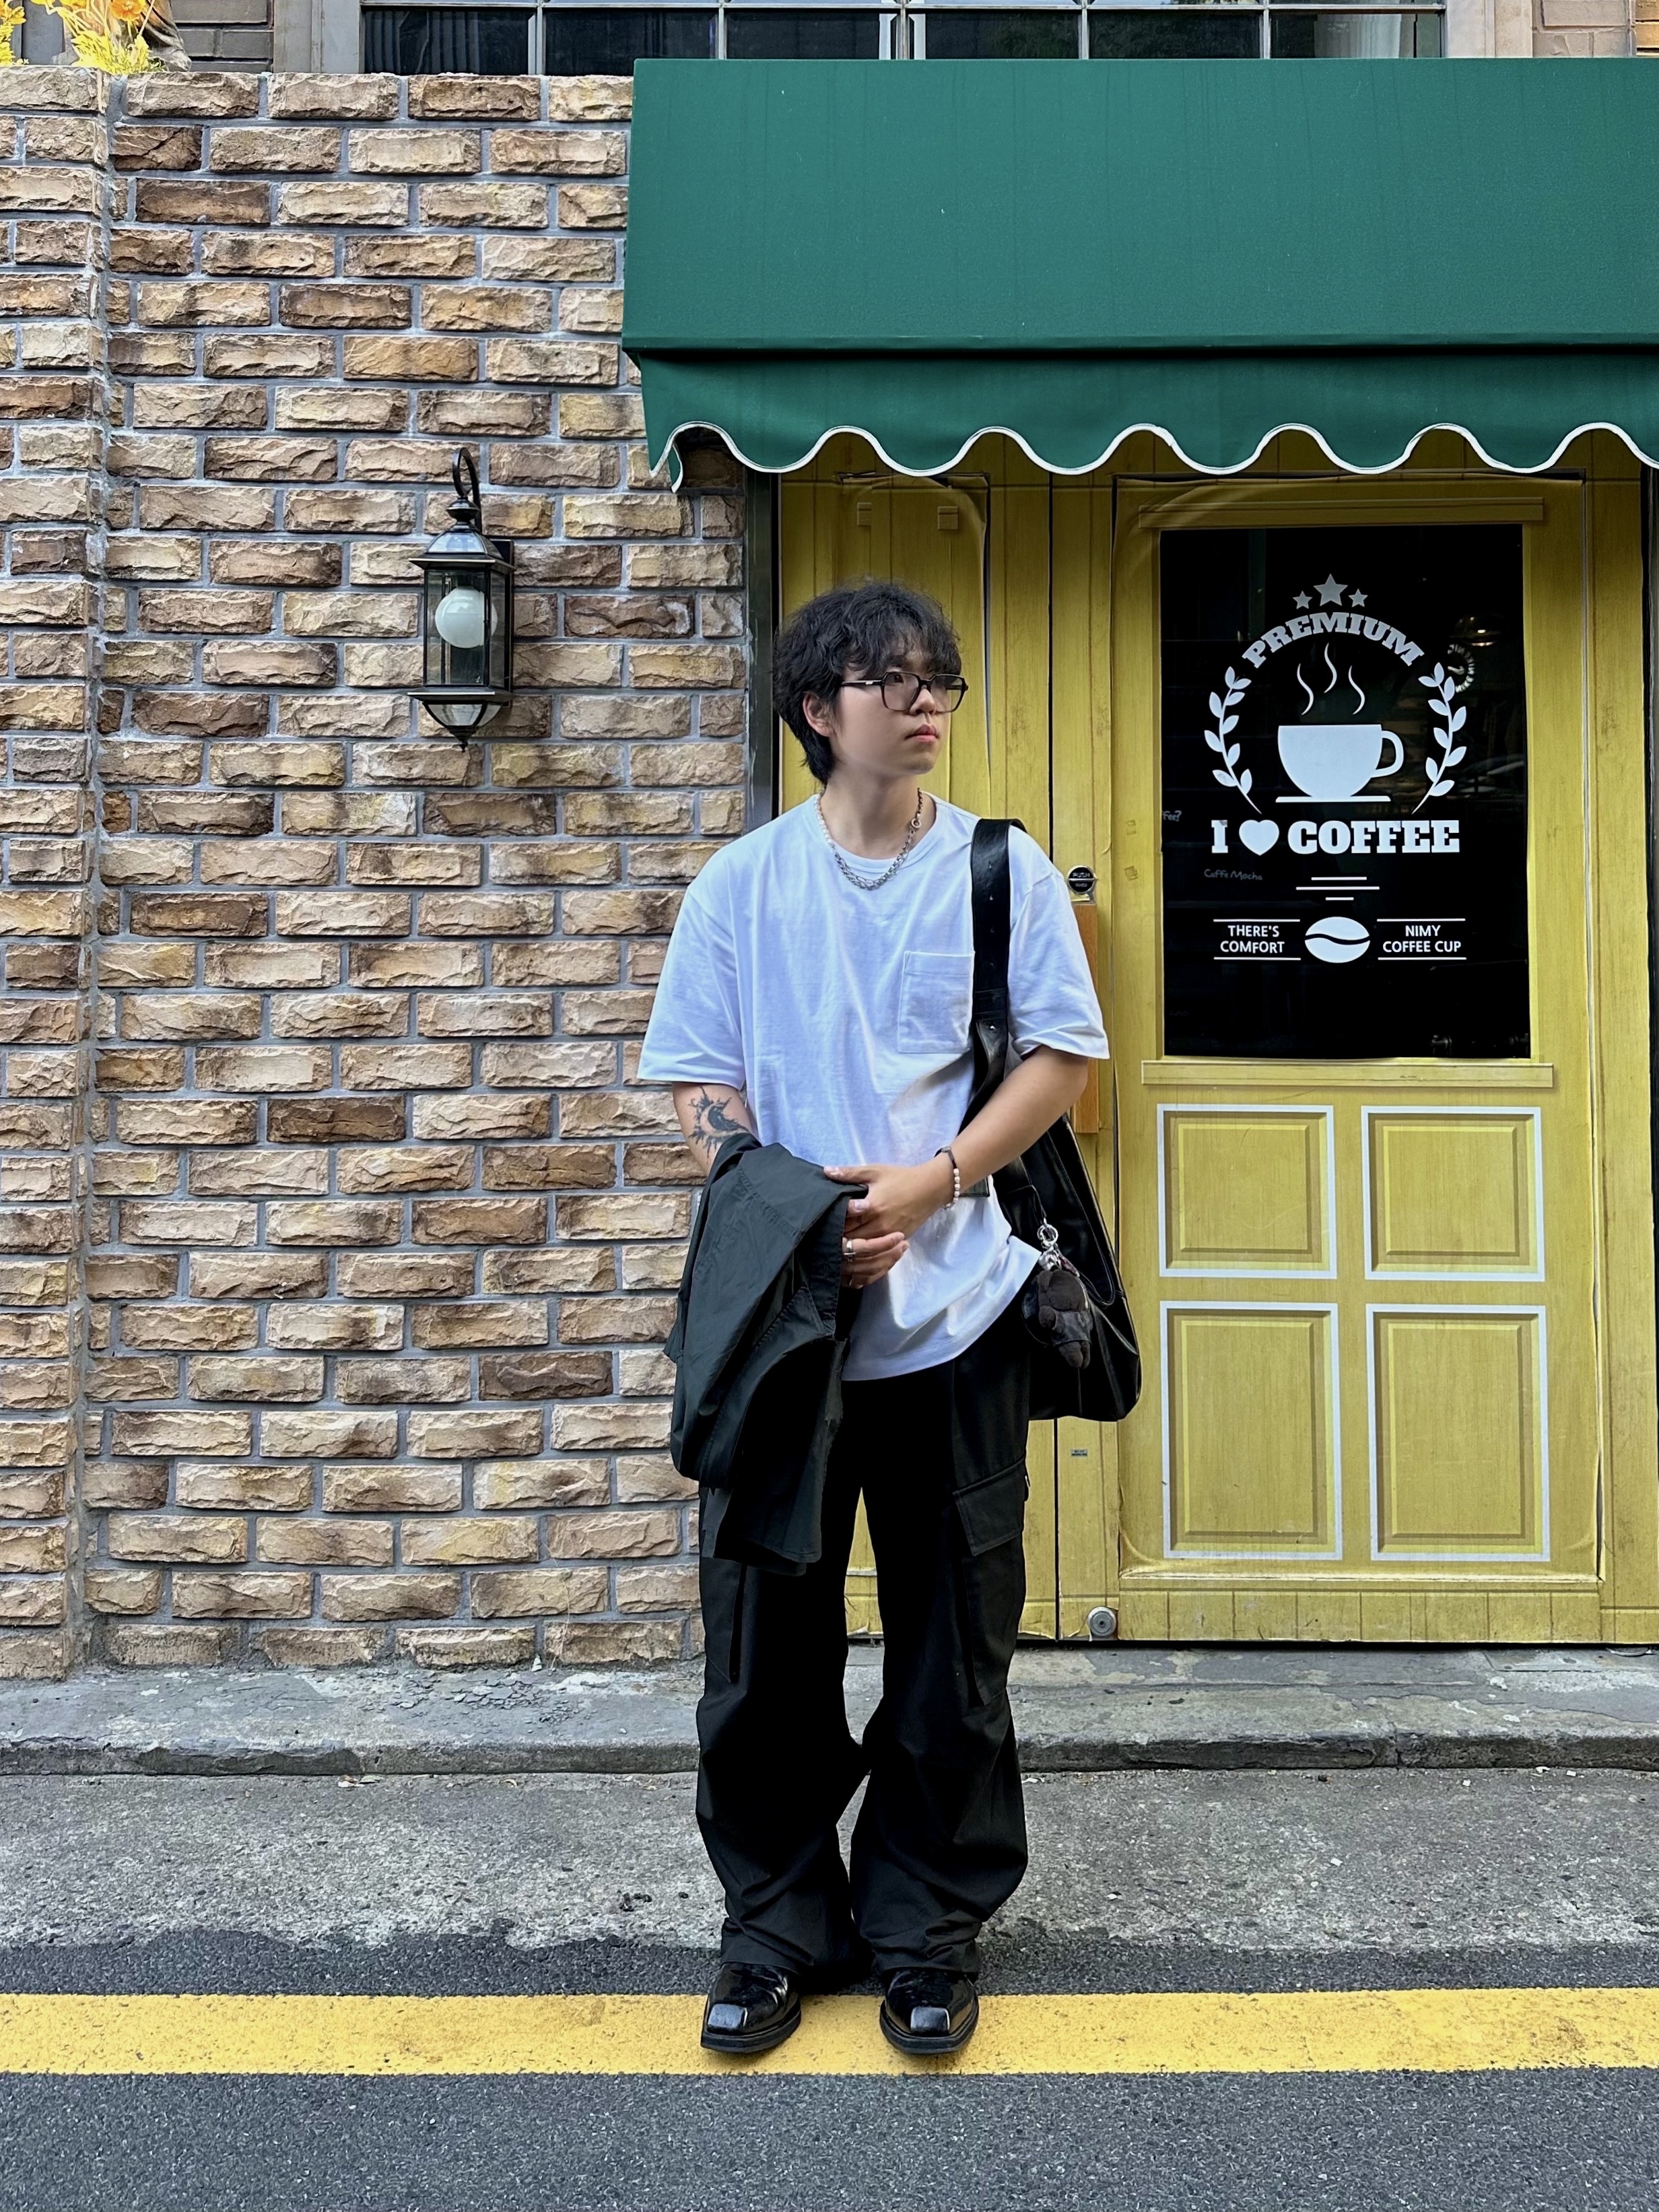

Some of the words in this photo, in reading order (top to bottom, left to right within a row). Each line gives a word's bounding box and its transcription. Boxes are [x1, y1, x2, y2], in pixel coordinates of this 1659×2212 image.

[1242, 612, 1424, 669] PREMIUM
[1162, 810, 1182, 822] fee?
[1211, 820, 1228, 853] I
[1288, 820, 1460, 854] COFFEE
[1230, 870, 1262, 880] Mocha
[1228, 925, 1279, 937] THERE'S
[1406, 925, 1441, 936] NIMY
[1221, 941, 1285, 953] COMFORT
[1383, 941, 1431, 952] COFFEE
[1435, 941, 1461, 952] CUP
